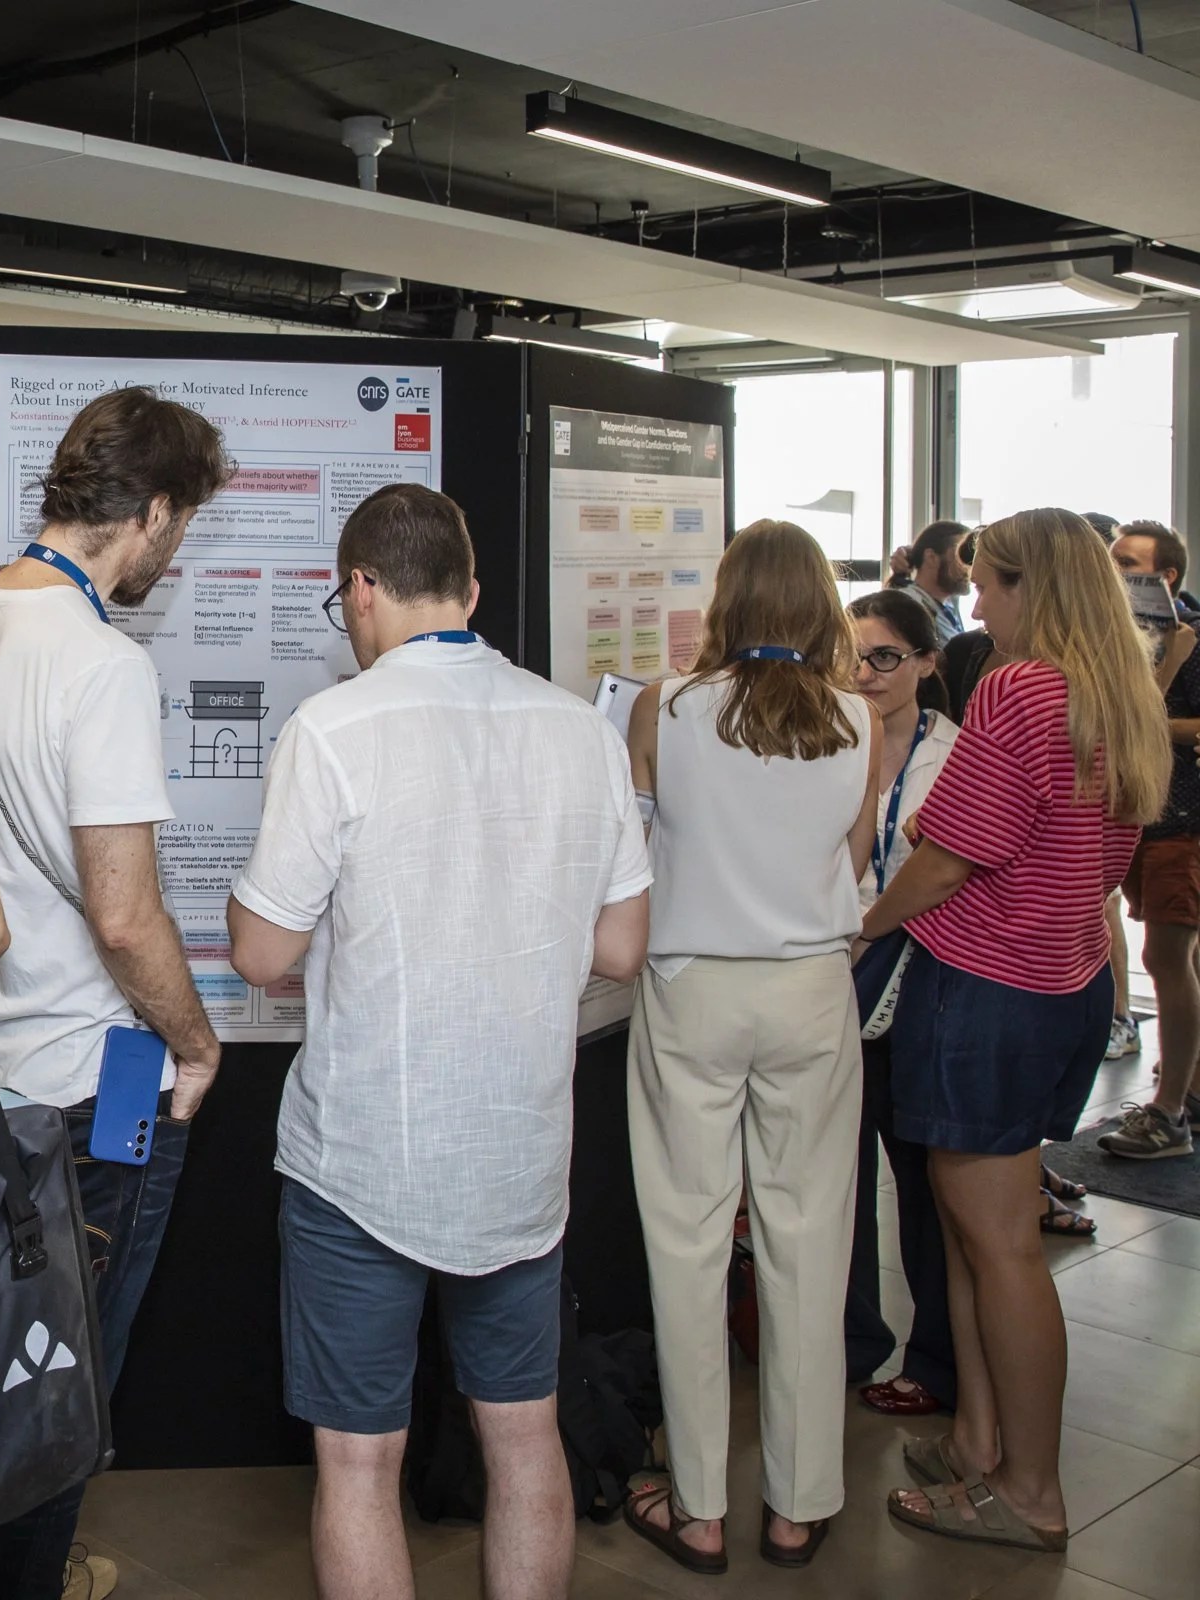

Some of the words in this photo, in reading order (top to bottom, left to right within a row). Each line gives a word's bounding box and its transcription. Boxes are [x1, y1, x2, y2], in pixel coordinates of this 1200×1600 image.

[11, 377, 55, 393] Rigged
[59, 382, 73, 390] or
[78, 380, 105, 391] not?
[159, 381, 177, 392] for
[182, 382, 245, 395] Motivated
[249, 384, 309, 397] Inference
[360, 385, 387, 399] cnrs
[396, 386, 430, 398] GATE
[10, 393, 50, 406] About
[10, 412, 69, 421] Konstantinos
[252, 418, 279, 427] Astrid
[555, 430, 570, 440] GATE
[209, 696, 244, 707] OFFICE
[868, 988, 900, 1037] JIMMY
